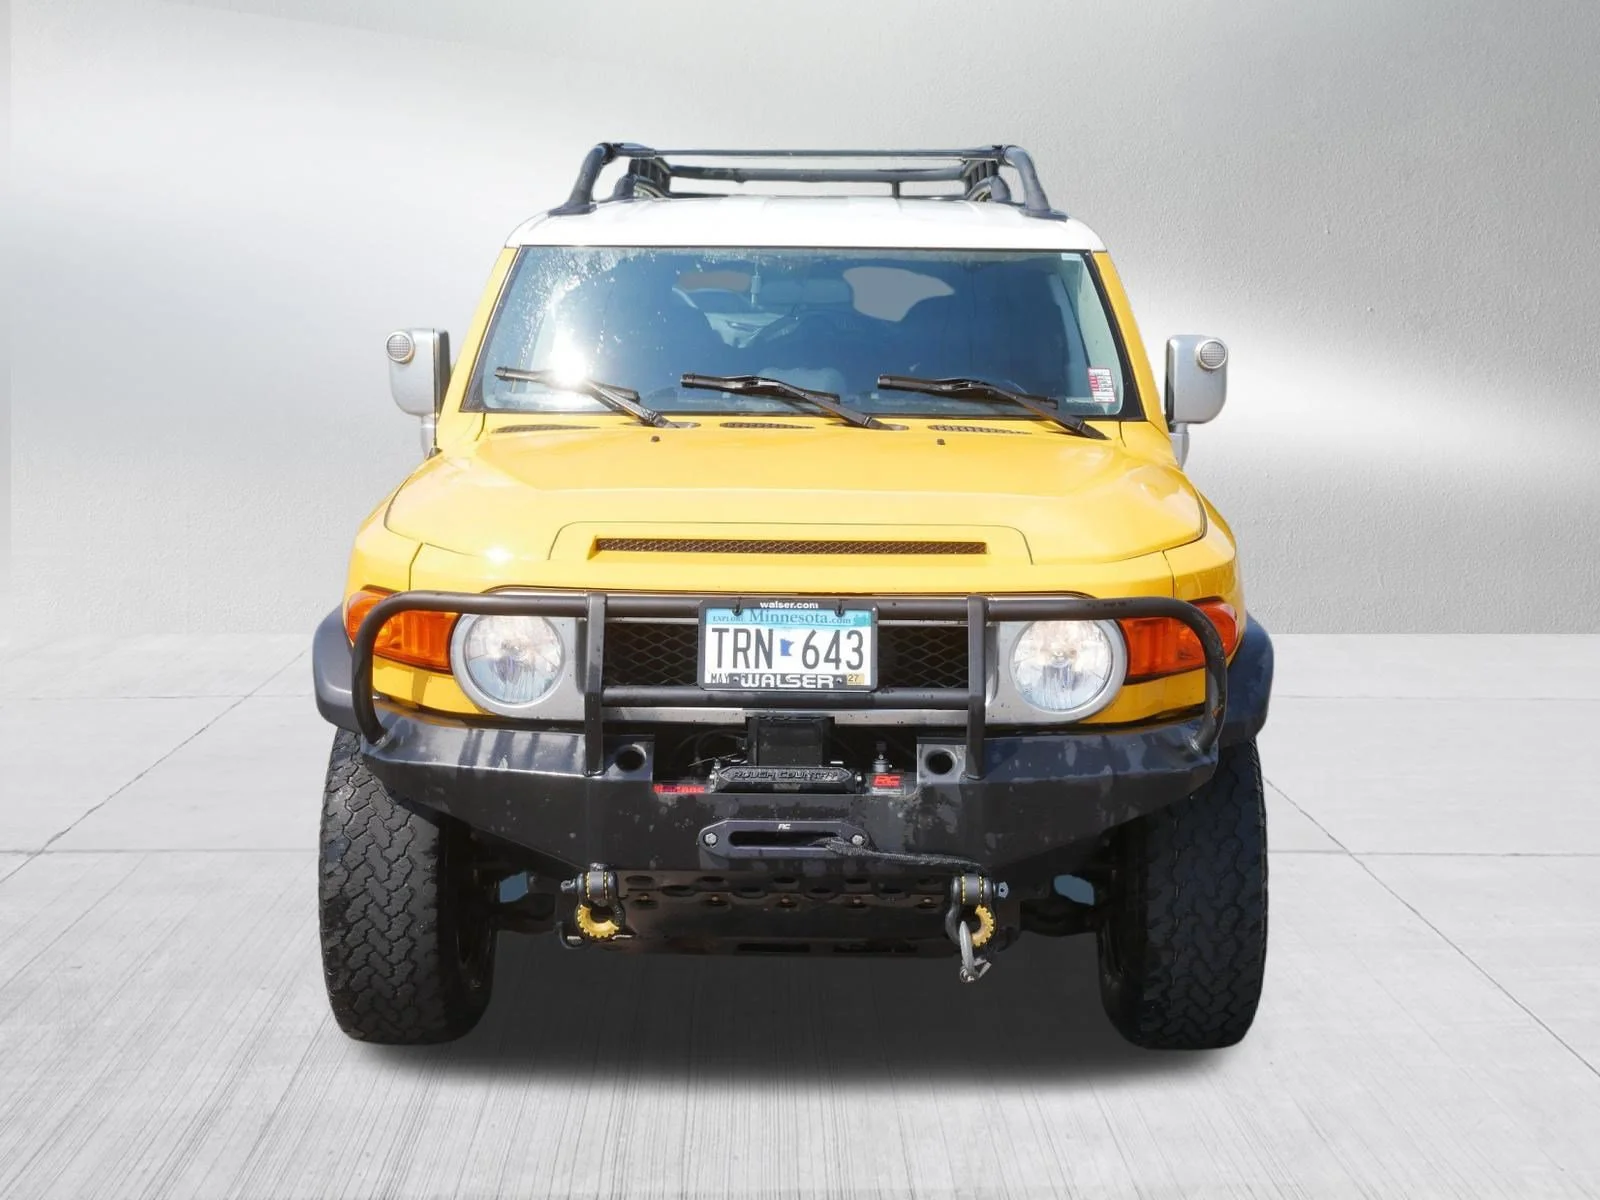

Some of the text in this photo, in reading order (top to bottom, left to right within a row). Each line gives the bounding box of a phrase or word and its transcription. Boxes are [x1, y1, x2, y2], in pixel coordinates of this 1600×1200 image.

[759, 600, 819, 609] walser.com
[711, 627, 864, 671] TRN 643
[711, 673, 730, 684] MAY
[740, 673, 834, 689] WALSER
[848, 673, 859, 682] 27
[734, 770, 839, 780] ROUGH COUNTRY
